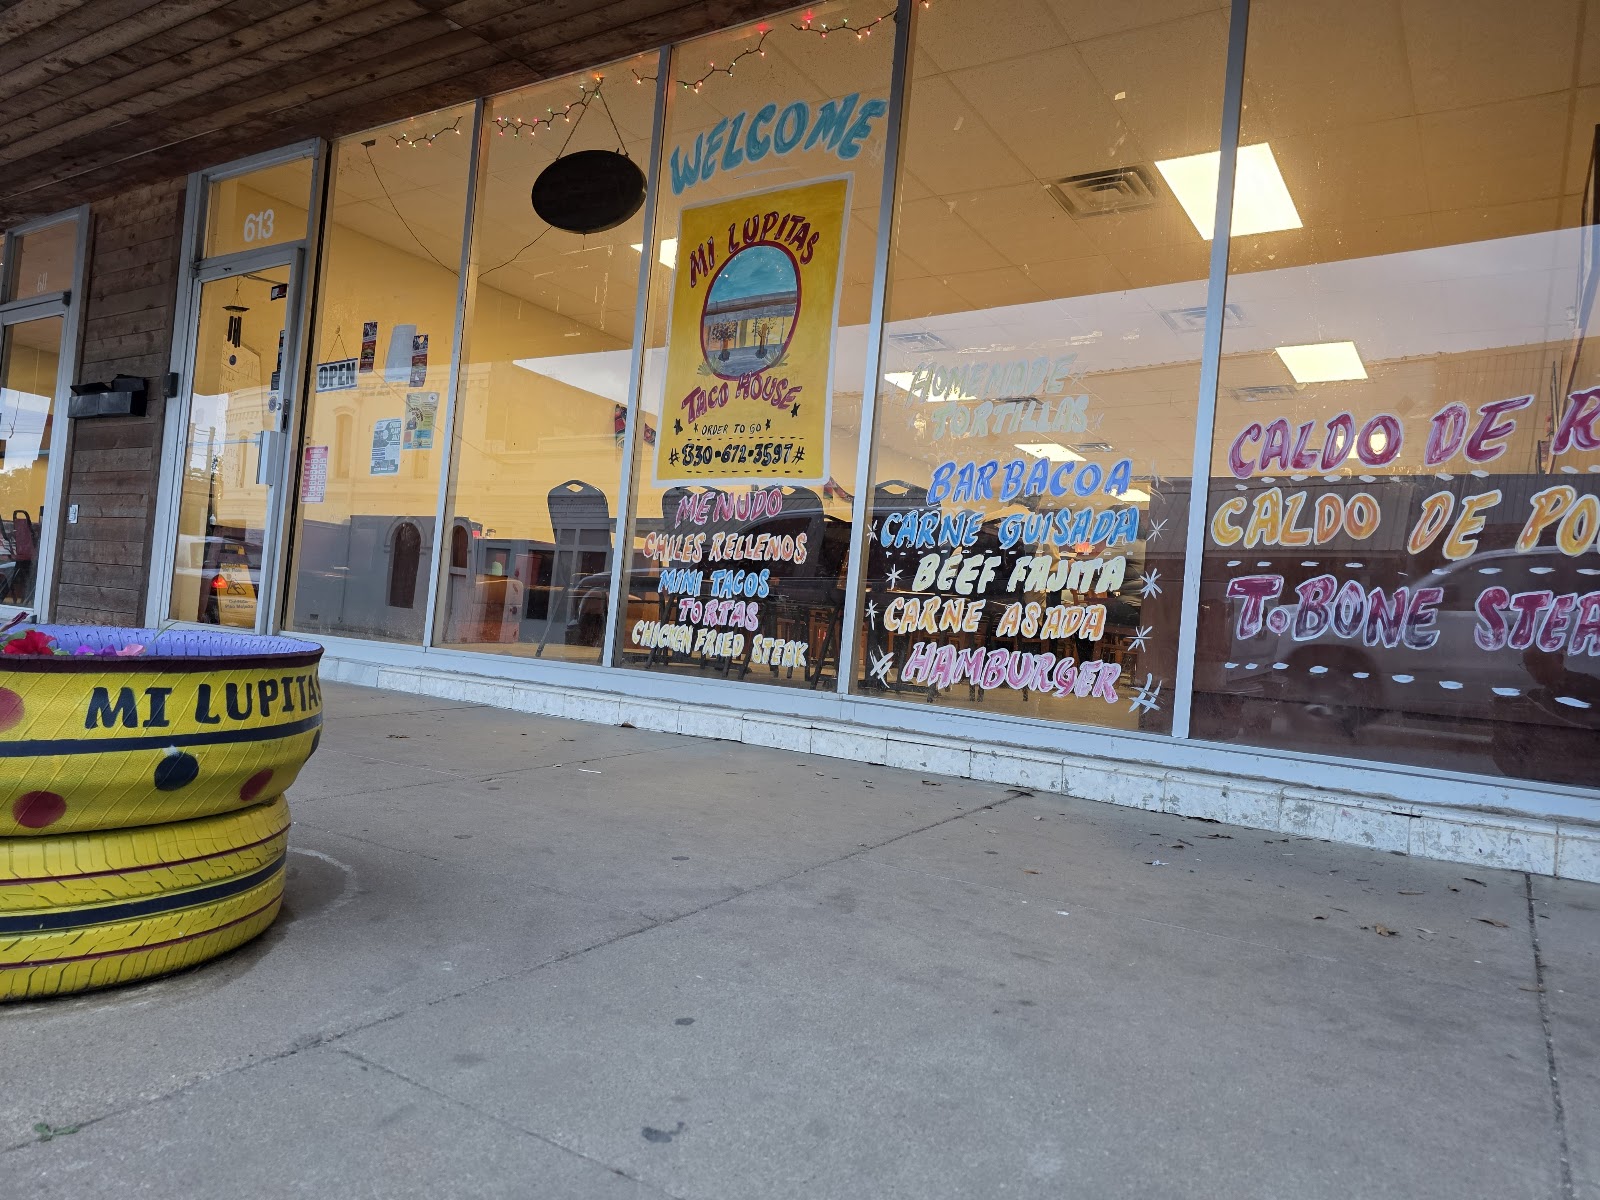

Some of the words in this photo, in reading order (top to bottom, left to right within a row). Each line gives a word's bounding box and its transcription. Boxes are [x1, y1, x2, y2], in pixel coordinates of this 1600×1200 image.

[669, 92, 889, 196] WELCOME
[244, 209, 275, 242] 613
[689, 235, 715, 289] MI
[728, 211, 820, 265] LUPITAS
[318, 362, 356, 389] OPEN
[681, 381, 729, 424] TACO
[735, 367, 804, 411] HOUSE
[905, 351, 1078, 409] HOMEMADE
[701, 423, 729, 436] ORDER
[734, 423, 746, 434] TO
[750, 423, 762, 434] GO
[931, 395, 1090, 441] TORTILLAS
[1227, 409, 1404, 480] CALDO
[1424, 393, 1536, 468] DE
[926, 456, 1134, 507] BARBACOA
[674, 488, 783, 529] MENUDO
[880, 507, 984, 549] CARNE
[997, 506, 1140, 550] GUISADA
[1211, 486, 1382, 550] CALDO
[1407, 488, 1502, 561] DE
[1515, 484, 1600, 558] PO
[642, 531, 707, 564] CHILES
[708, 531, 808, 565] RELLENOS
[657, 568, 704, 597] MINI
[710, 568, 771, 599] TACOS
[912, 552, 1001, 595] BEEF
[1006, 553, 1127, 595] FAJITA
[678, 597, 759, 632] TORTAS
[883, 596, 987, 635] CARNE
[996, 601, 1107, 642] ASADA
[631, 619, 693, 655] CHICKEN
[695, 627, 745, 659] FRIED
[751, 633, 809, 668] STEAK
[902, 640, 1122, 705] HAMBURGER
[84, 686, 173, 730] MI
